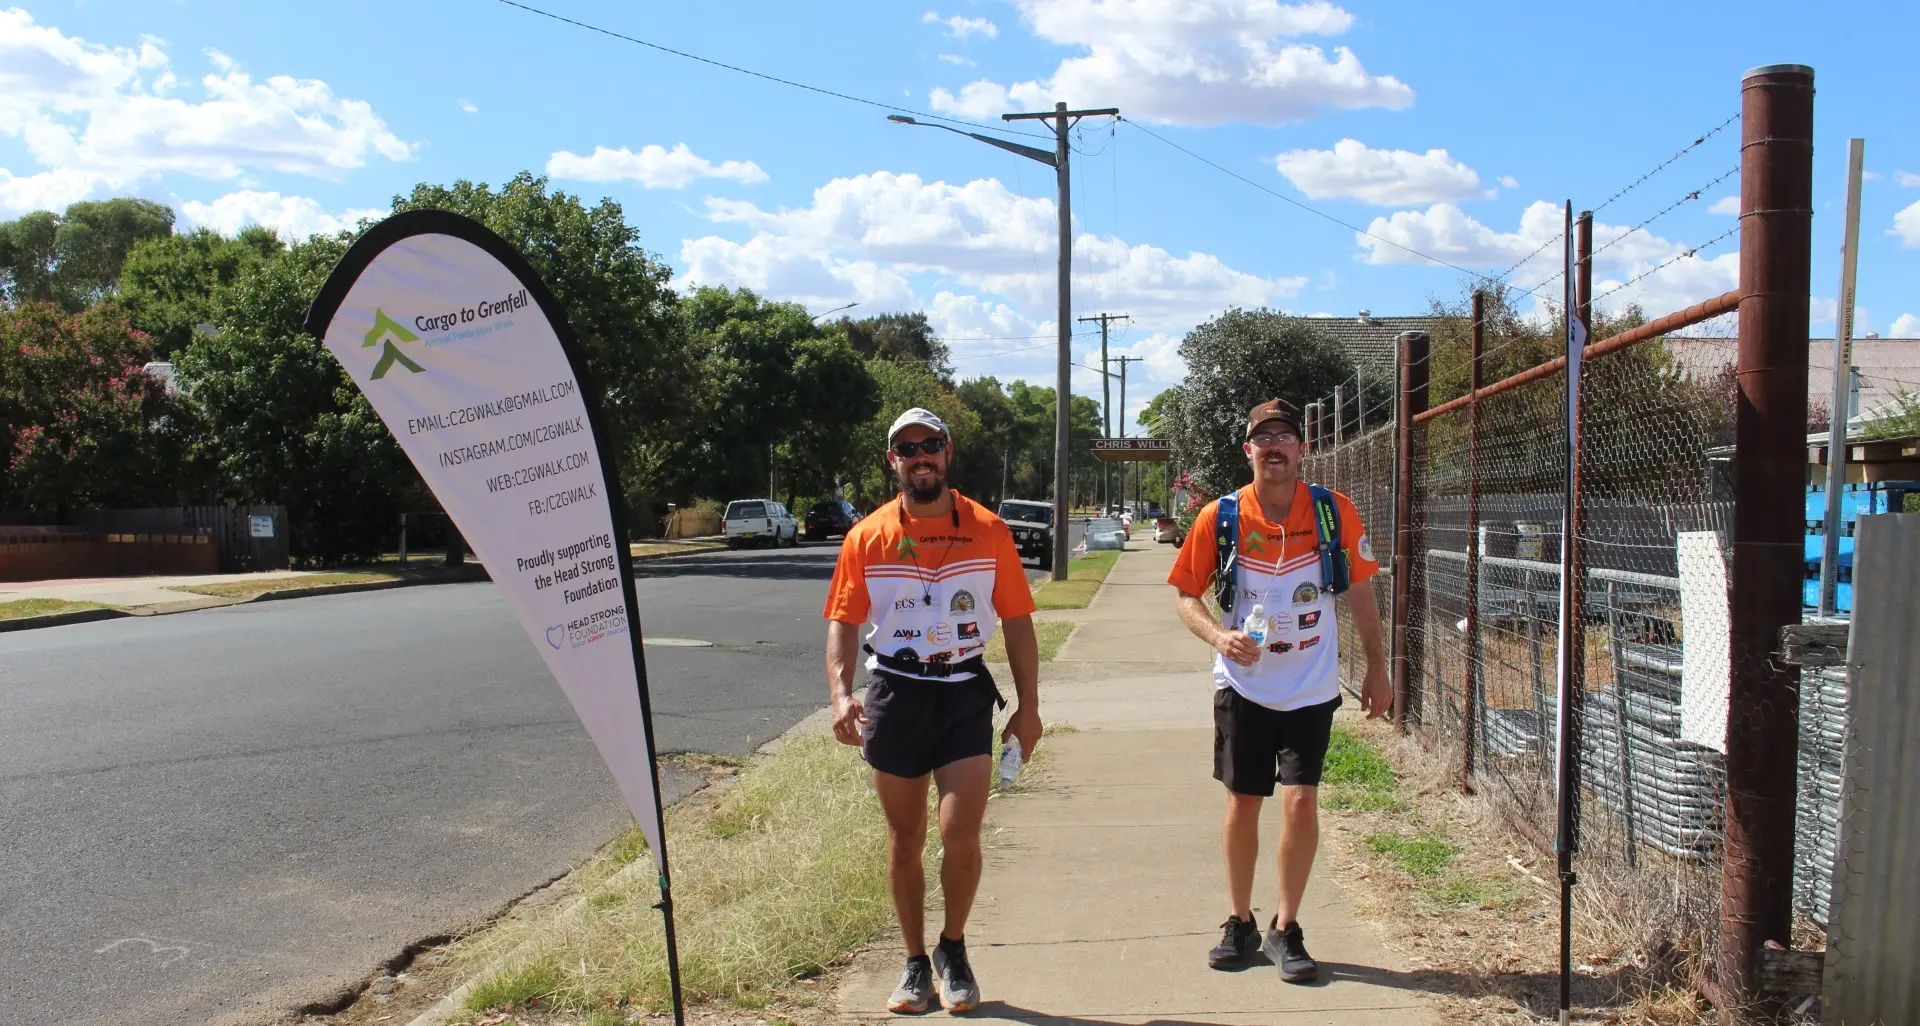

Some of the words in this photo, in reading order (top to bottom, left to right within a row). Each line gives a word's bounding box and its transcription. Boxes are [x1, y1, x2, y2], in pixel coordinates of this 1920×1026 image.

[415, 312, 457, 331] Cargo
[460, 307, 475, 323] to
[478, 289, 528, 318] Grenfell
[494, 320, 515, 331] Walk
[408, 380, 575, 435] EMAIL:C2GWALK@GMAIL.COM
[439, 416, 583, 468] INSTAGRAM.COM/C2GWALK
[1095, 440, 1132, 449] CHRIS
[1137, 440, 1170, 449] WILLI
[486, 451, 590, 493] WEB:C2GWALK.COM
[528, 483, 597, 516] FB:/C2GWALK
[517, 549, 555, 572] Proudly
[557, 533, 611, 560] supporting
[920, 535, 937, 543] Cargo
[534, 574, 552, 590] the
[554, 563, 579, 584] Head
[581, 555, 615, 575] Strong
[564, 577, 619, 604] Foundation
[894, 598, 915, 610] ECS
[567, 616, 589, 631] HEAD
[591, 605, 624, 623] STRONG
[569, 616, 627, 642] FOUNDATION
